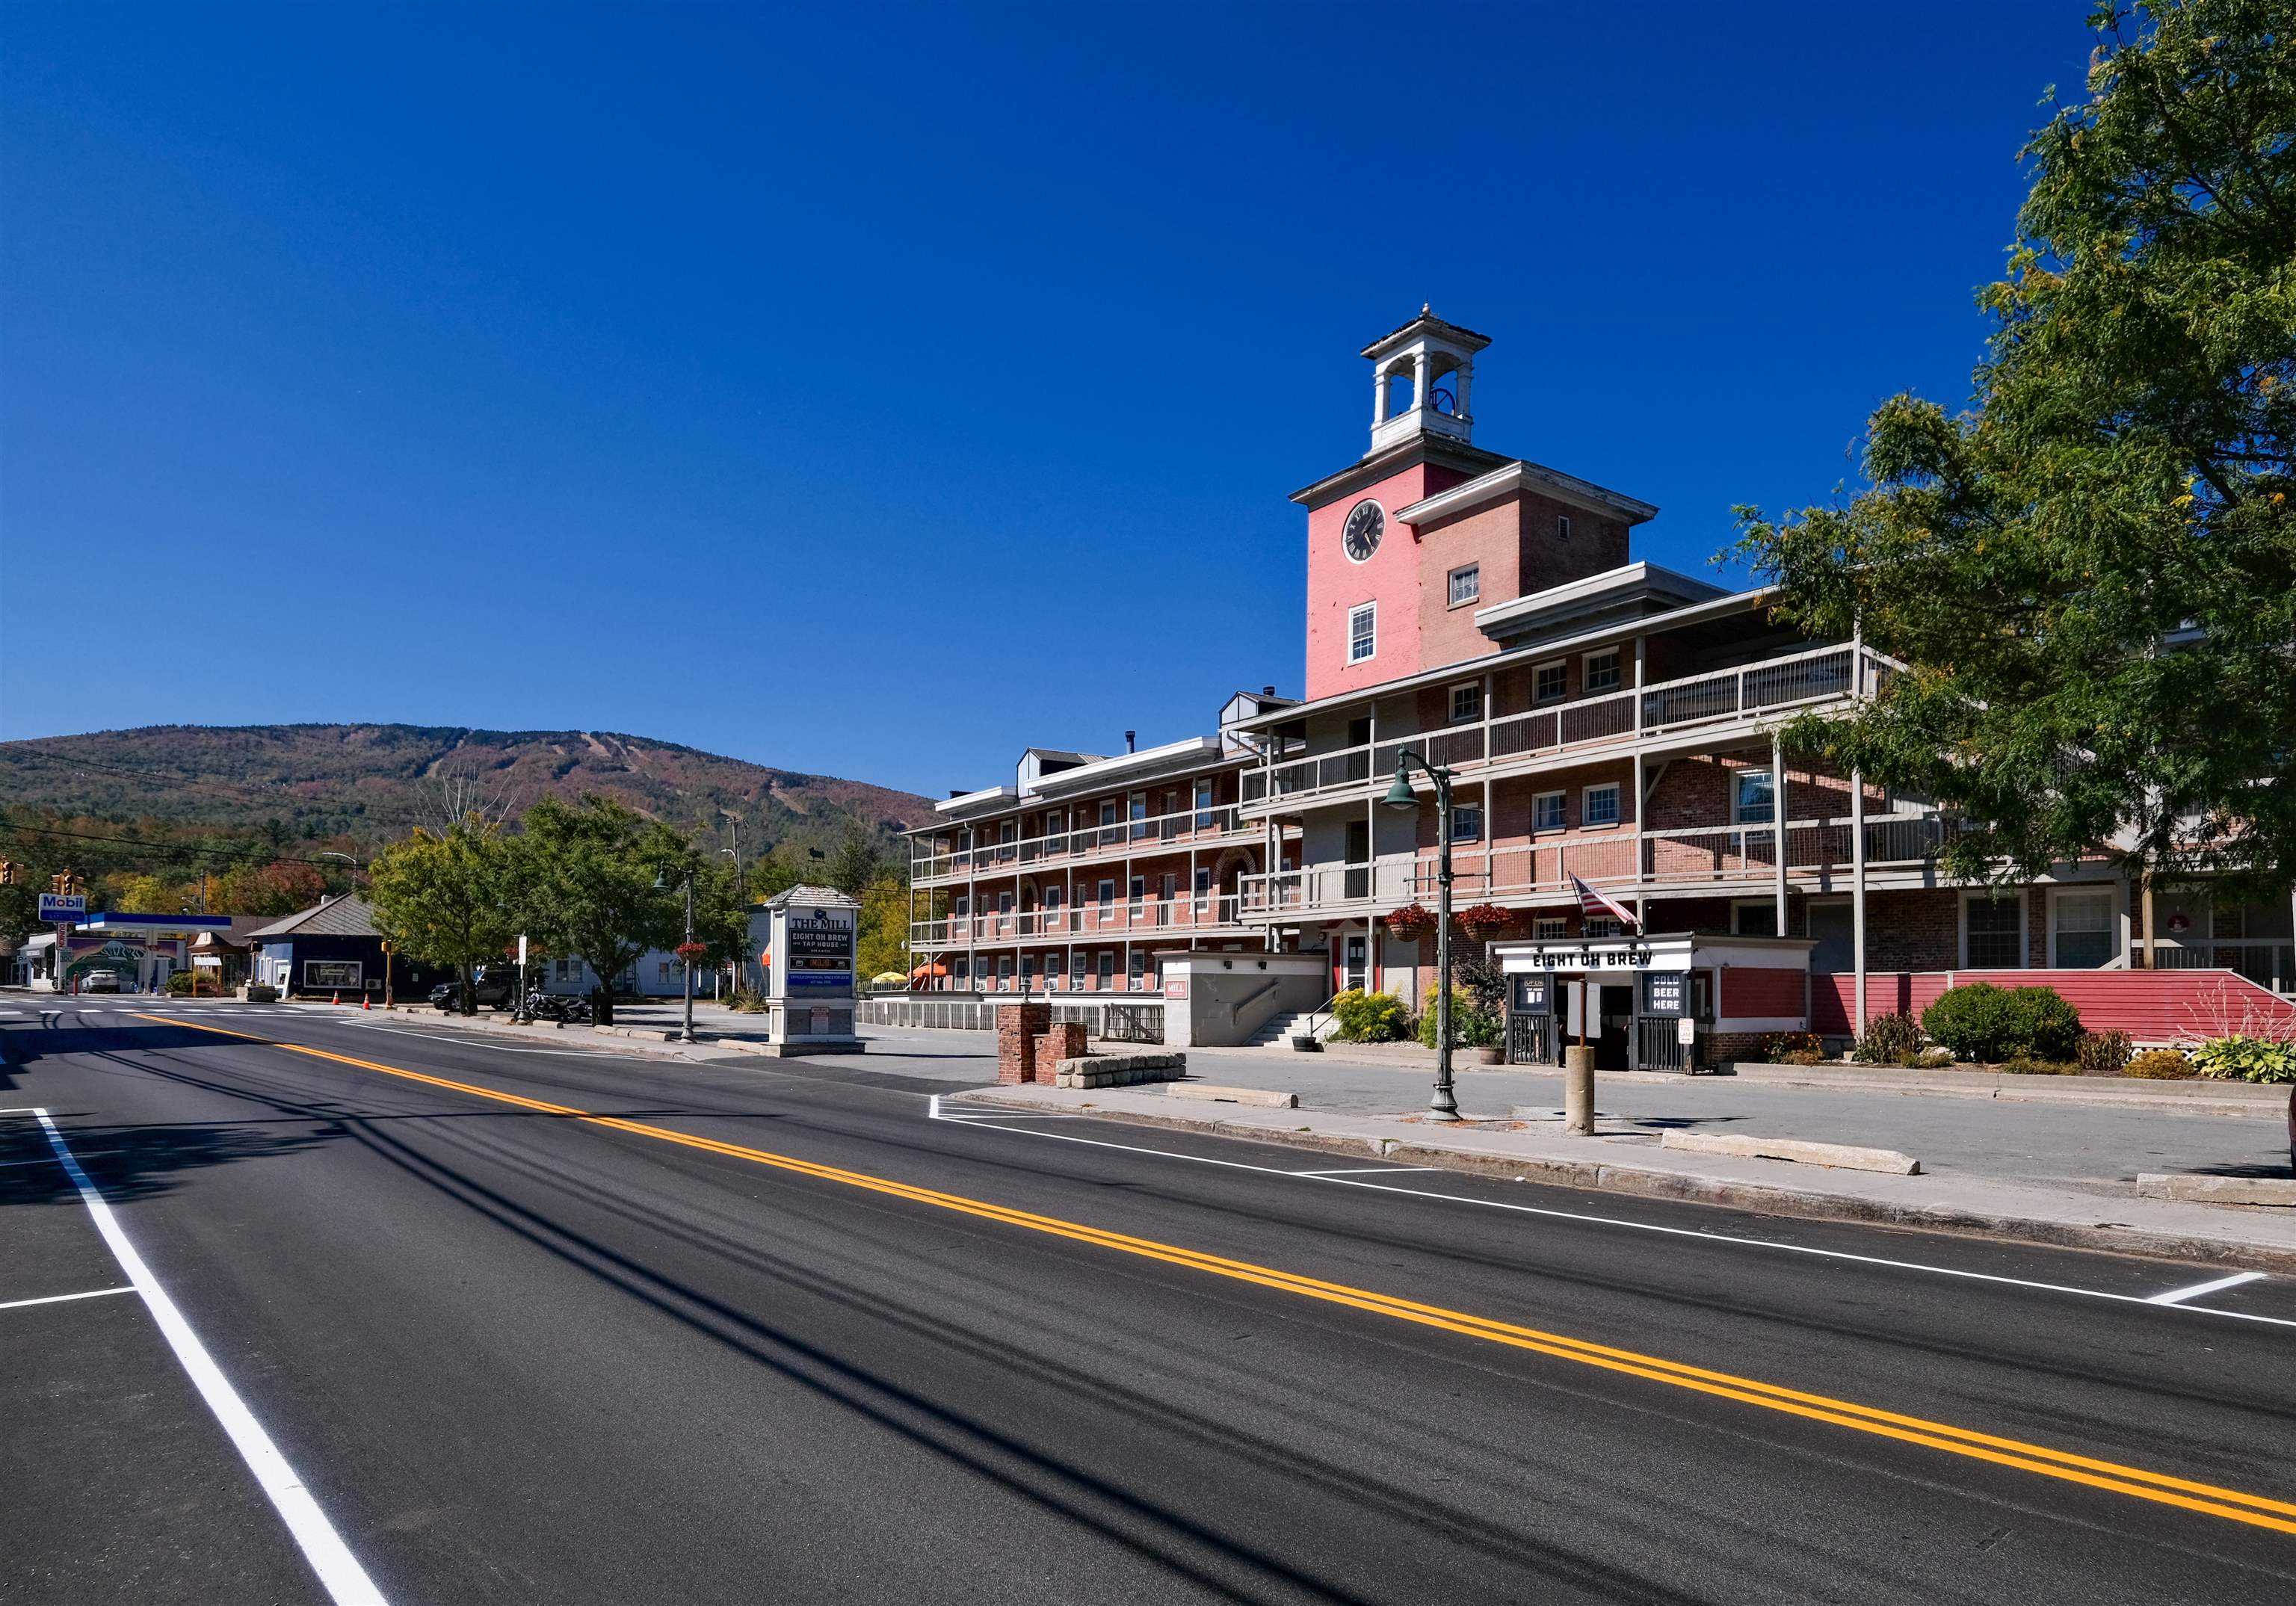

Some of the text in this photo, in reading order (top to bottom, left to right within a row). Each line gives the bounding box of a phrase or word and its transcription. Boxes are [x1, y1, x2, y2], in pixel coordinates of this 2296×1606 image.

[43, 896, 83, 907] Mobil
[792, 918, 851, 929] THE MILL
[1533, 951, 1652, 967] EIGHT OH BREW
[1653, 975, 1679, 985] COLD
[1167, 984, 1185, 992] MILL
[1653, 988, 1679, 998] BEER
[1653, 1000, 1679, 1010] HERE
